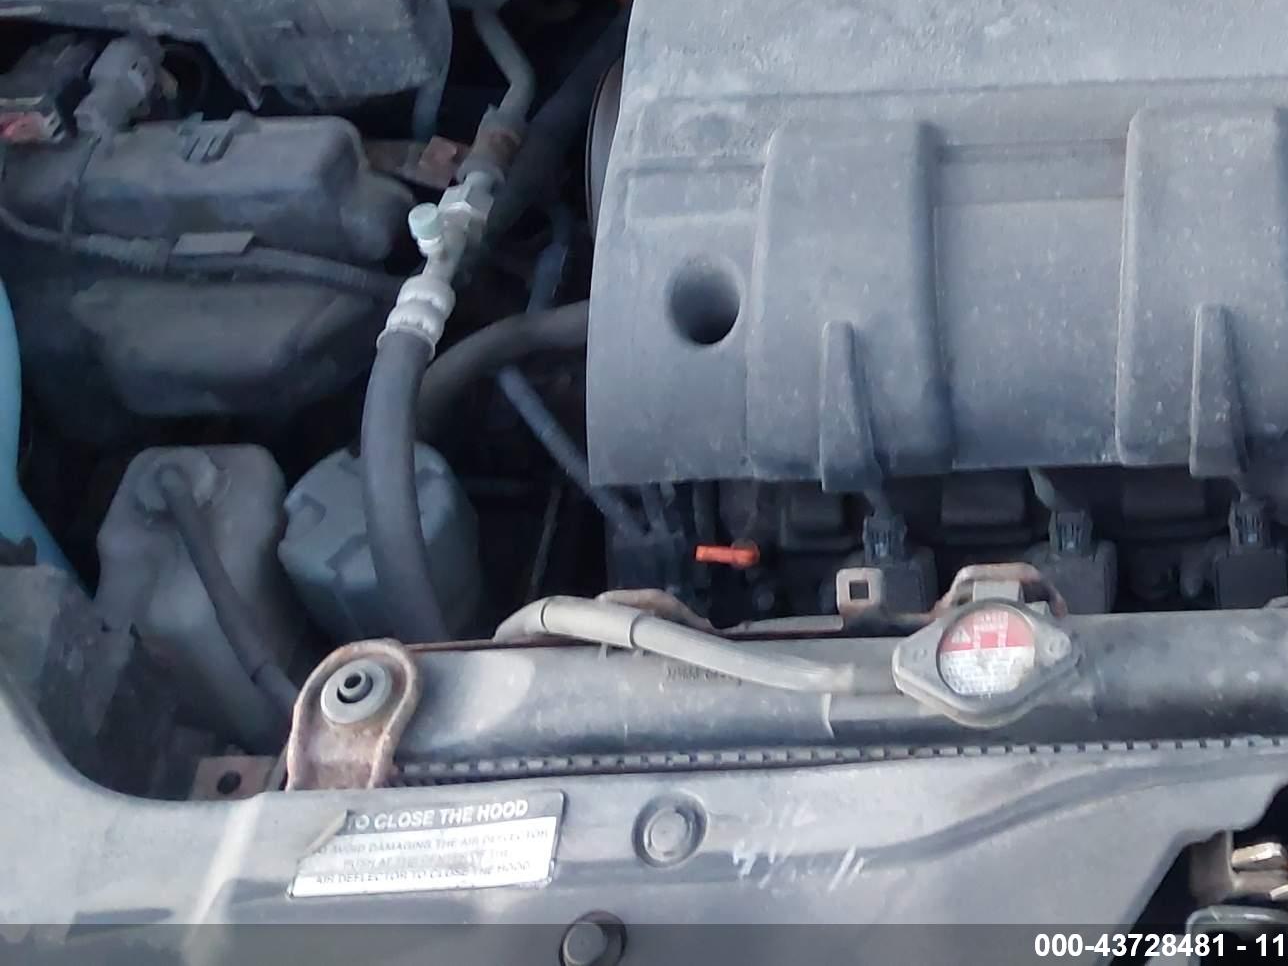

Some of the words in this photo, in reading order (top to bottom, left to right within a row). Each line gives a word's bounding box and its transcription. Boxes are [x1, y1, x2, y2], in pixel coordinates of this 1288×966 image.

[374, 809, 434, 831] CLOSE
[439, 805, 474, 825] THE
[477, 799, 529, 821] HOOD
